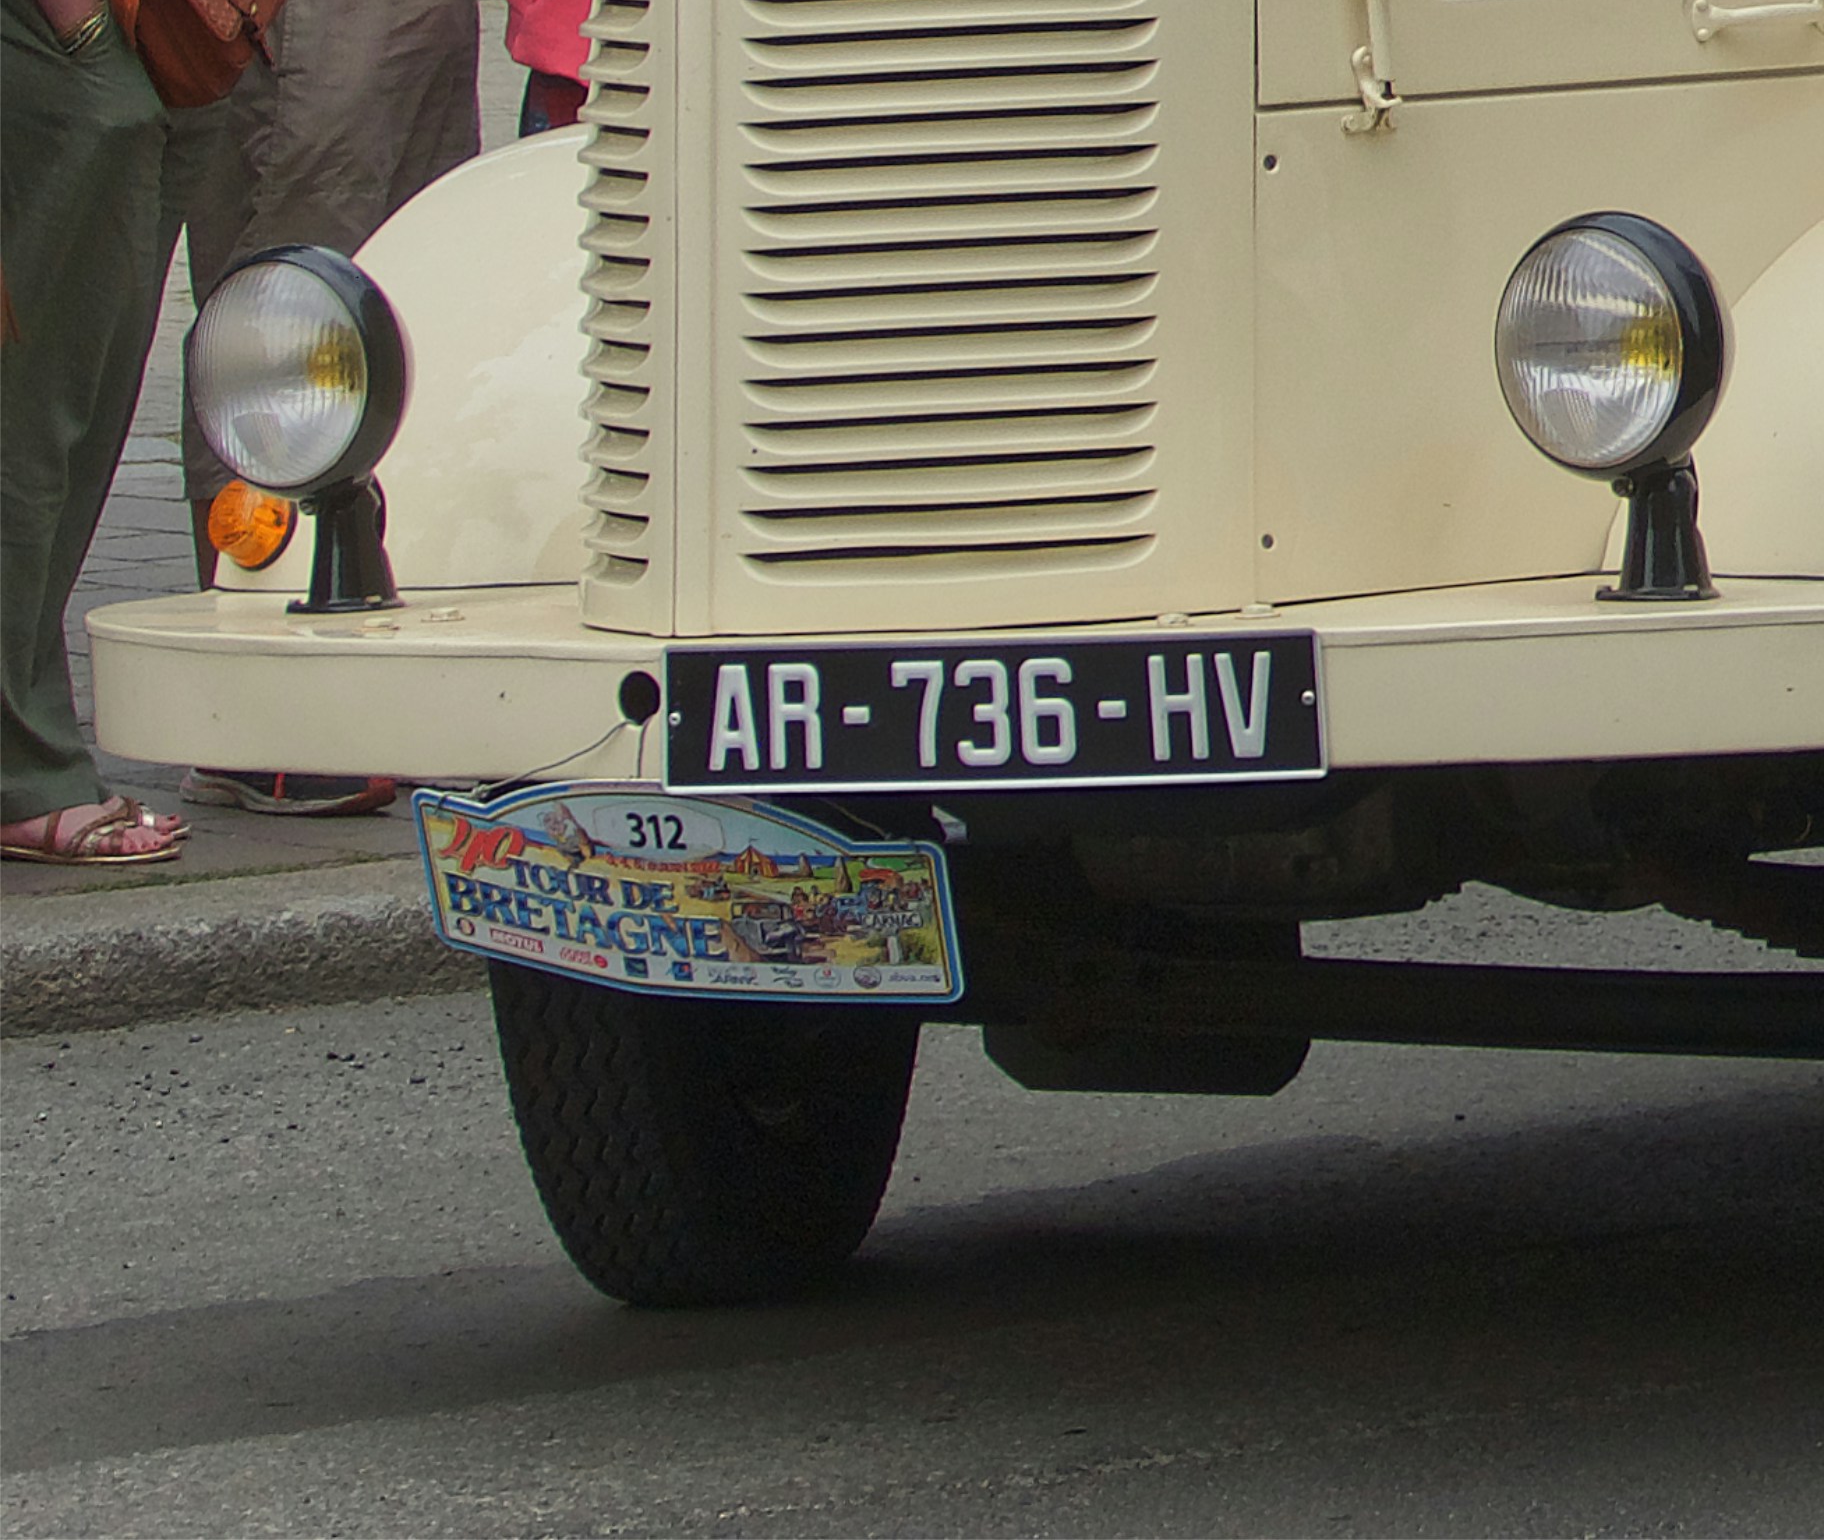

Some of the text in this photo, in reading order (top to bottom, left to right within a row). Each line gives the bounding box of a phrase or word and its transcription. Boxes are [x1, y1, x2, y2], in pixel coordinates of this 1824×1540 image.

[625, 812, 687, 851] 312
[509, 857, 615, 907] TOUR
[620, 879, 680, 913] DE
[442, 871, 733, 961] BRETAGNE
[491, 930, 543, 953] MOTUL
